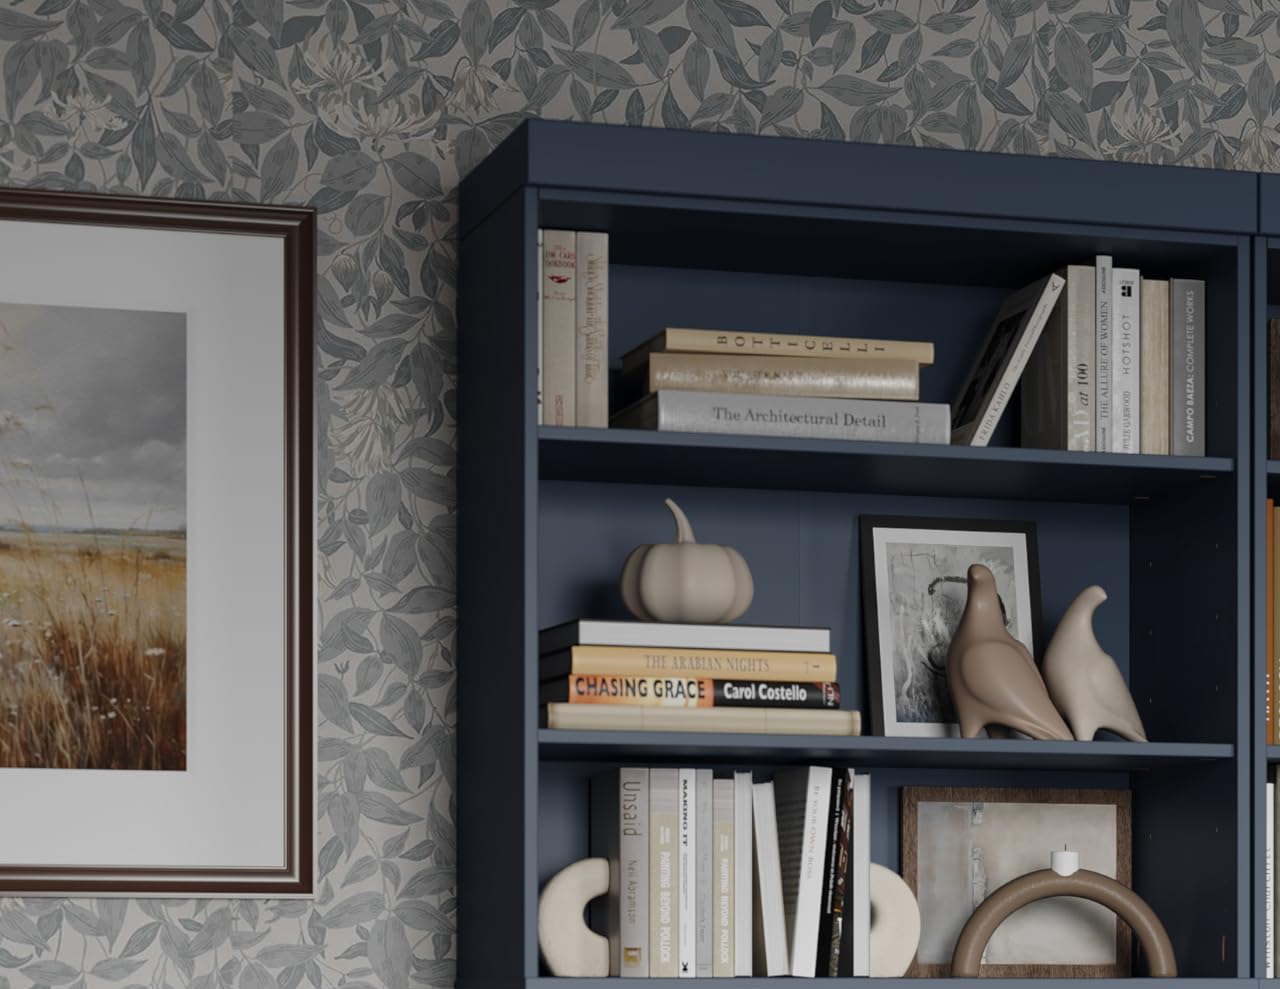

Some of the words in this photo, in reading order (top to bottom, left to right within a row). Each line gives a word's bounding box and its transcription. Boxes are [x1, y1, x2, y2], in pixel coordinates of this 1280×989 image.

[1185, 290, 1195, 323] WORKS
[1100, 301, 1110, 341] WOMEN
[716, 335, 886, 353] BOTTICELLI
[1100, 341, 1110, 357] OF
[1121, 314, 1131, 375] HOTSHOT
[1185, 324, 1195, 373] COMPLETE
[1100, 358, 1110, 399] ALLURE
[712, 406, 742, 422] The
[744, 407, 839, 426] Architectural
[843, 412, 887, 428] Detail
[1100, 400, 1110, 420] THE
[1186, 407, 1195, 443] CAMPO
[645, 655, 670, 670] THE
[672, 656, 724, 672] ARABIAN
[727, 658, 770, 673] NIGHTS
[576, 677, 648, 698] CHASING
[653, 678, 706, 700] GRACE
[723, 683, 757, 700] Carol
[758, 684, 807, 702] Costello
[622, 781, 643, 837] Unsaid
[682, 833, 688, 847] IT
[627, 859, 638, 878] Neil
